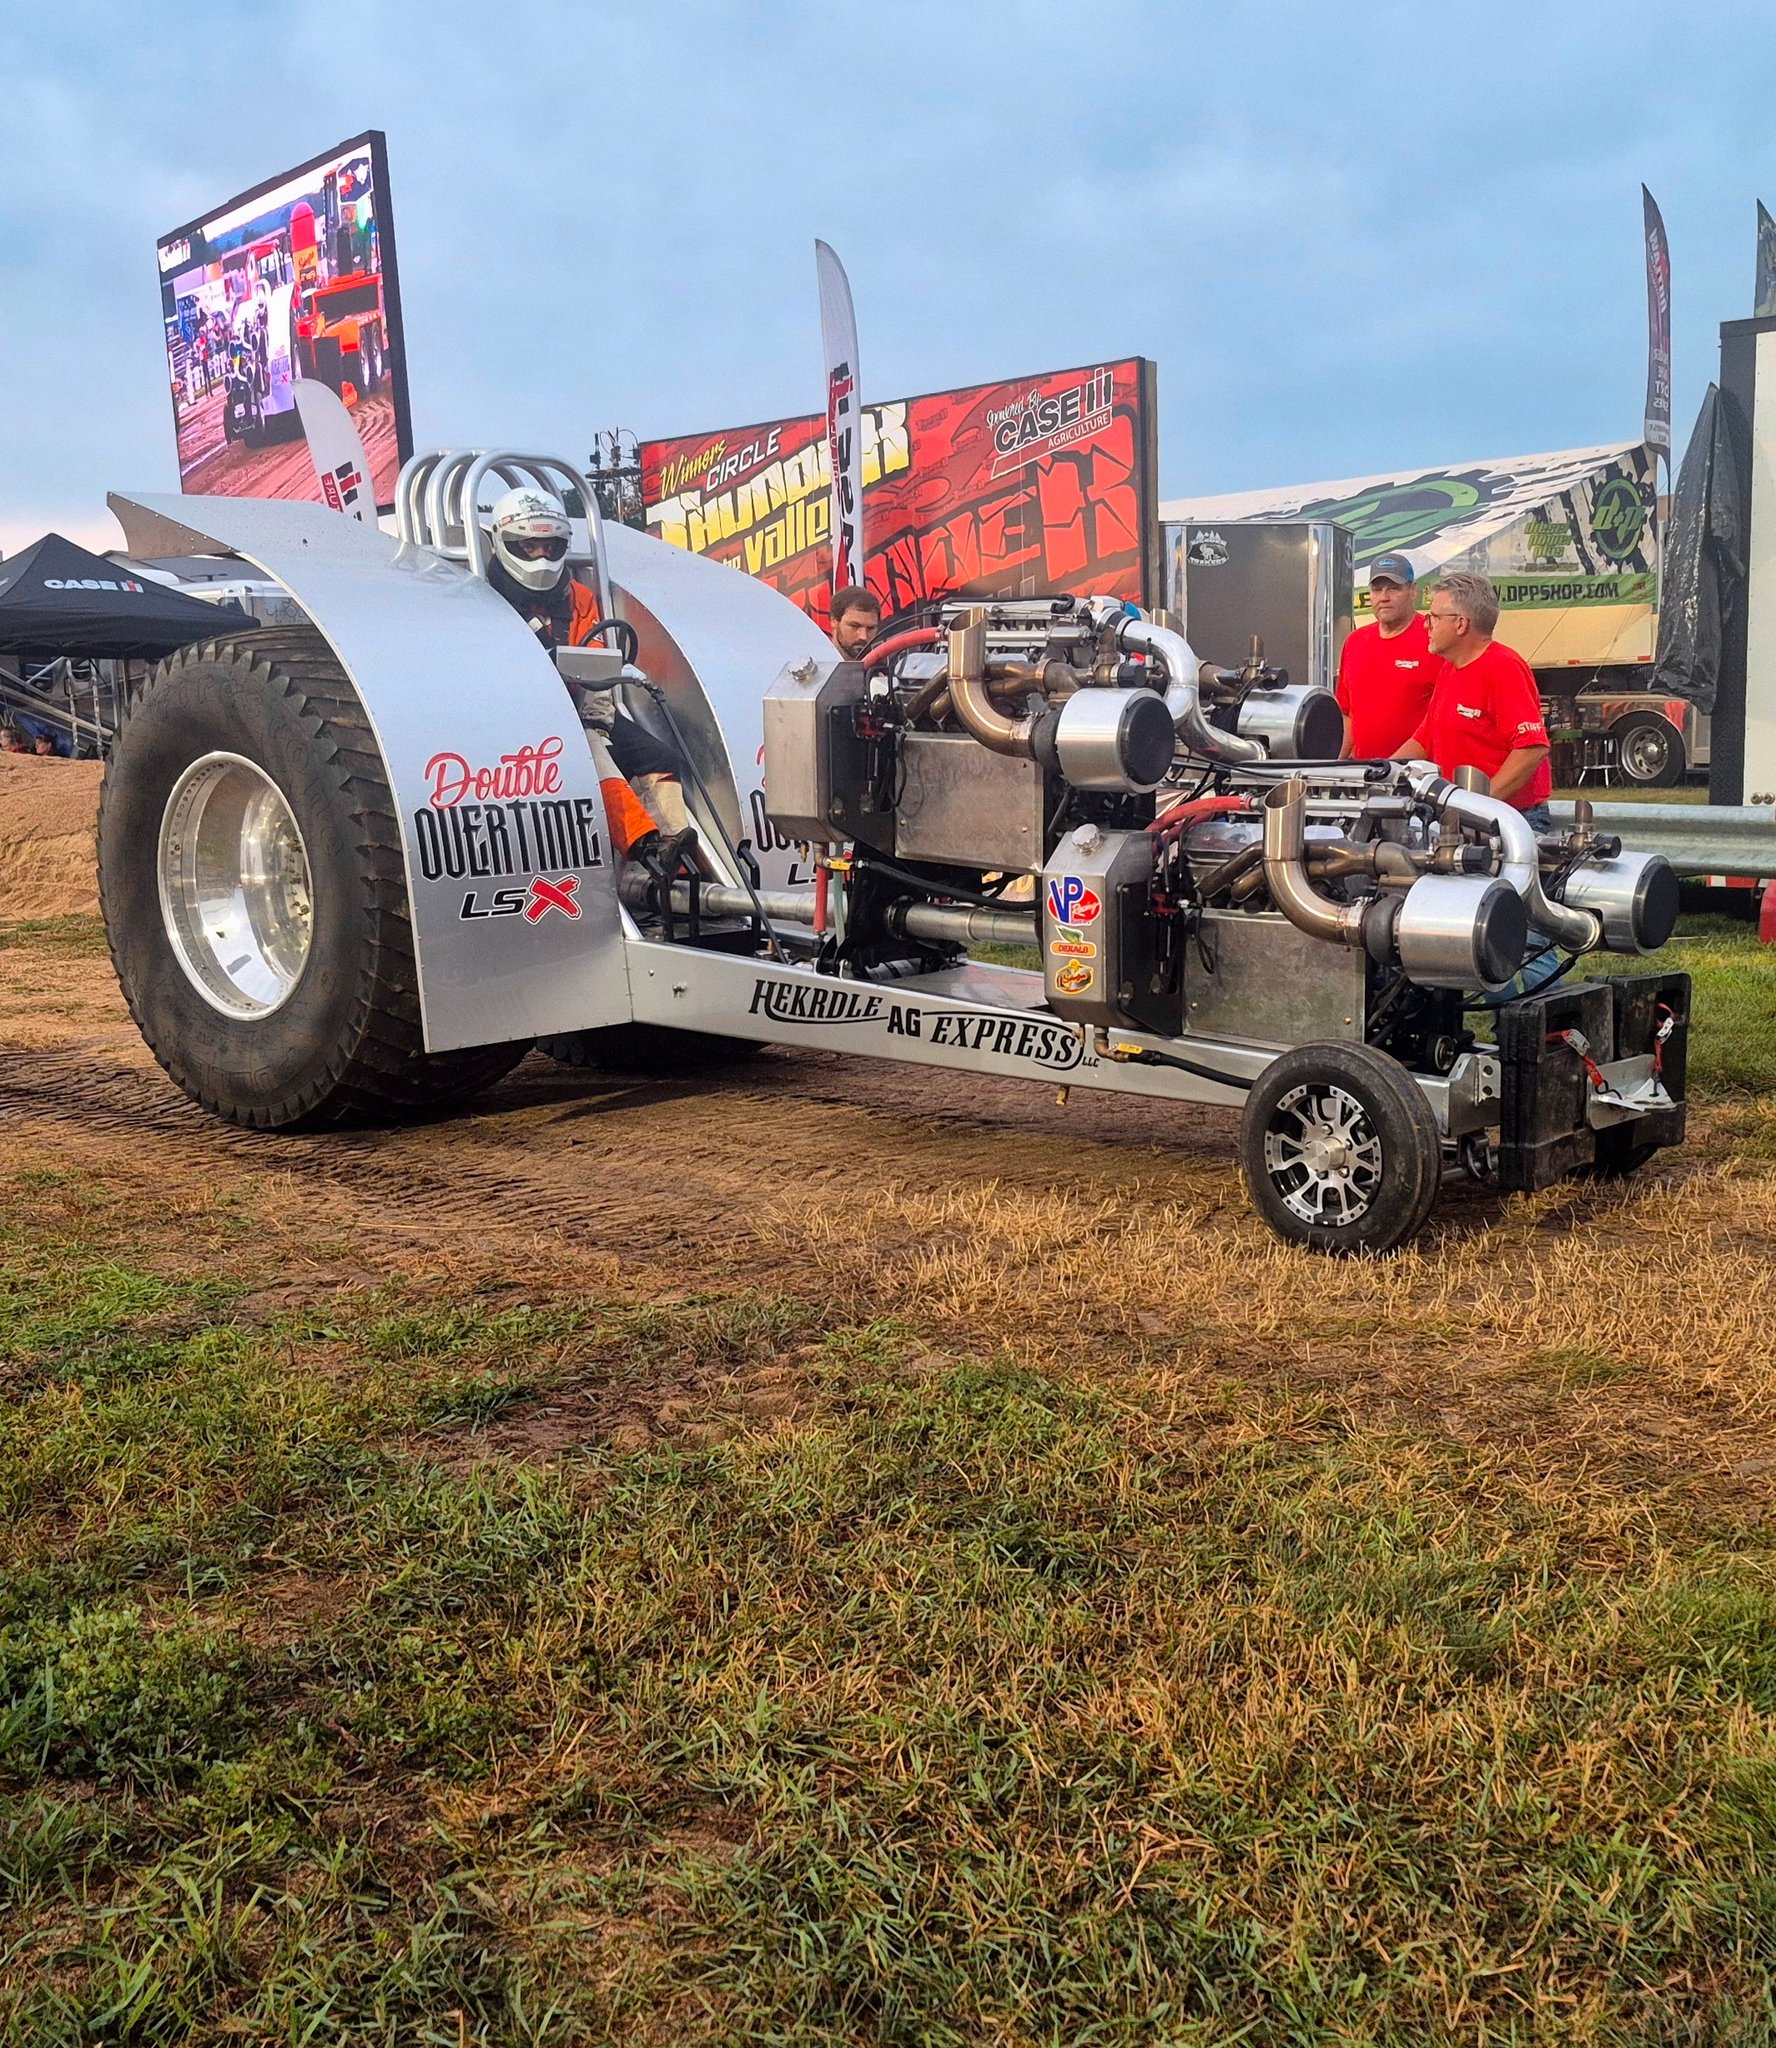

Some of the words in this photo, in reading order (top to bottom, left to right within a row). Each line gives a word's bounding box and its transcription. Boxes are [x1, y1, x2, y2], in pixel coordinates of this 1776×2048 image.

[994, 386, 1081, 455] CASE
[1048, 412, 1109, 449] AGRICULTURE
[646, 402, 909, 554] THUNDR
[659, 439, 727, 500] Winners
[706, 427, 782, 492] CIRCLE
[744, 496, 831, 575] valle
[44, 580, 119, 591] CASE
[424, 736, 564, 810] Double
[459, 874, 582, 925] LSX
[1049, 875, 1084, 924] VP
[1072, 901, 1100, 919] Racing
[749, 979, 883, 1020] HEKRDLE
[887, 1006, 921, 1037] AG
[930, 1015, 1079, 1065] EXPRESS
[1082, 1055, 1099, 1068] LLC
